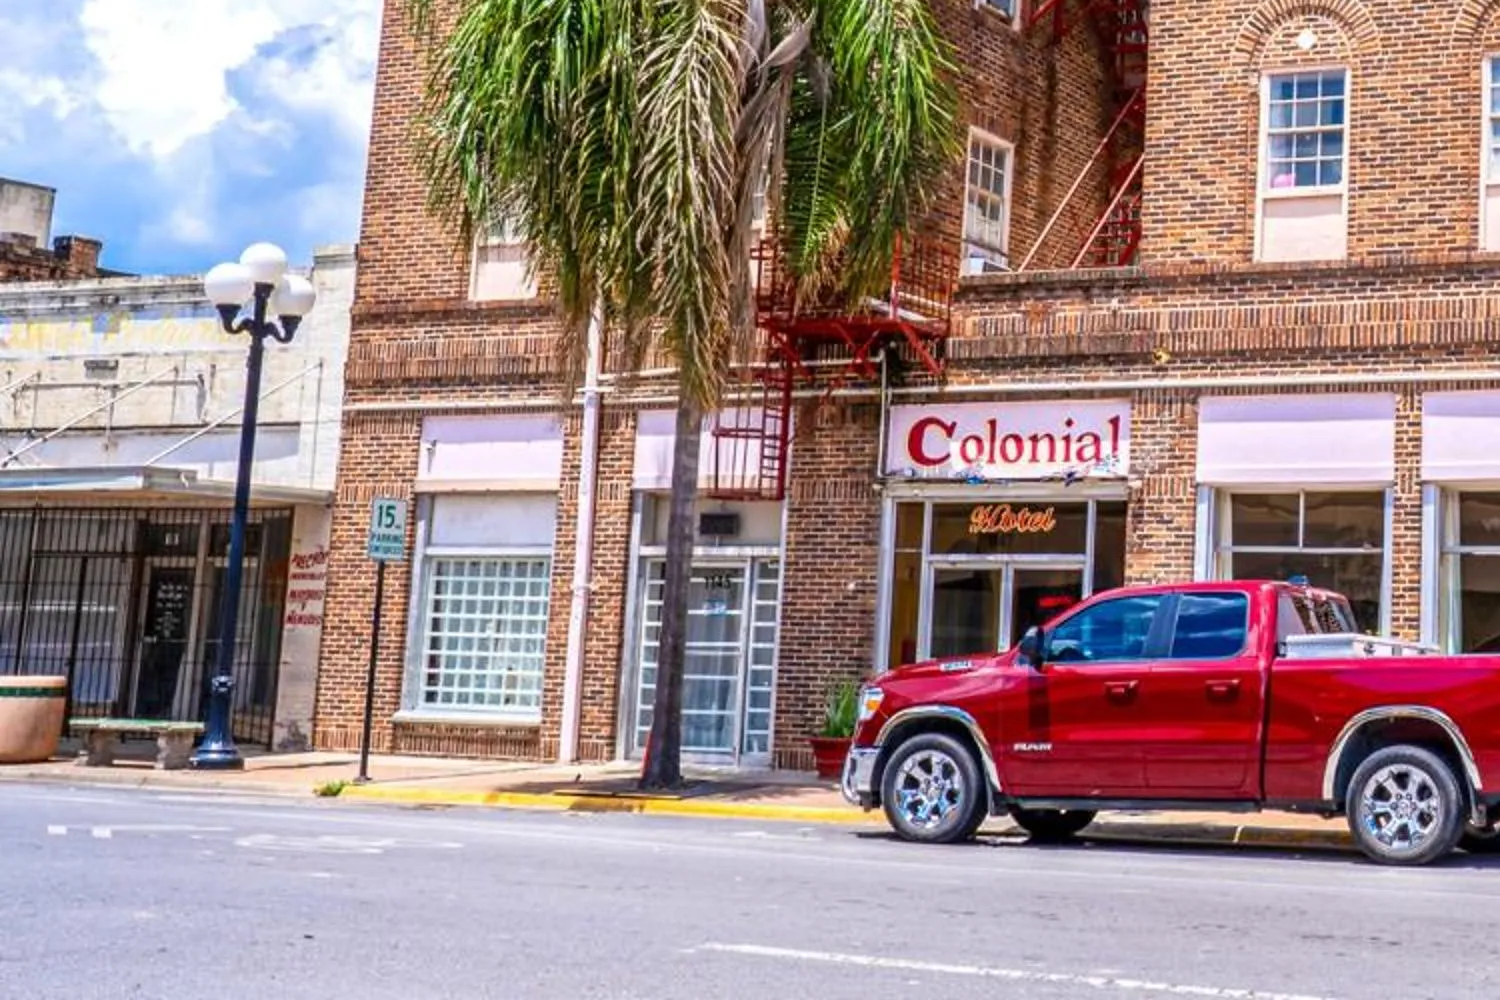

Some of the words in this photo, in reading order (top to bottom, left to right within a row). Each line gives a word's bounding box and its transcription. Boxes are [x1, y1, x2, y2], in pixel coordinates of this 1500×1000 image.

[907, 414, 1121, 468] Colonial
[377, 505, 397, 529] 15
[968, 503, 1056, 534] Hotel
